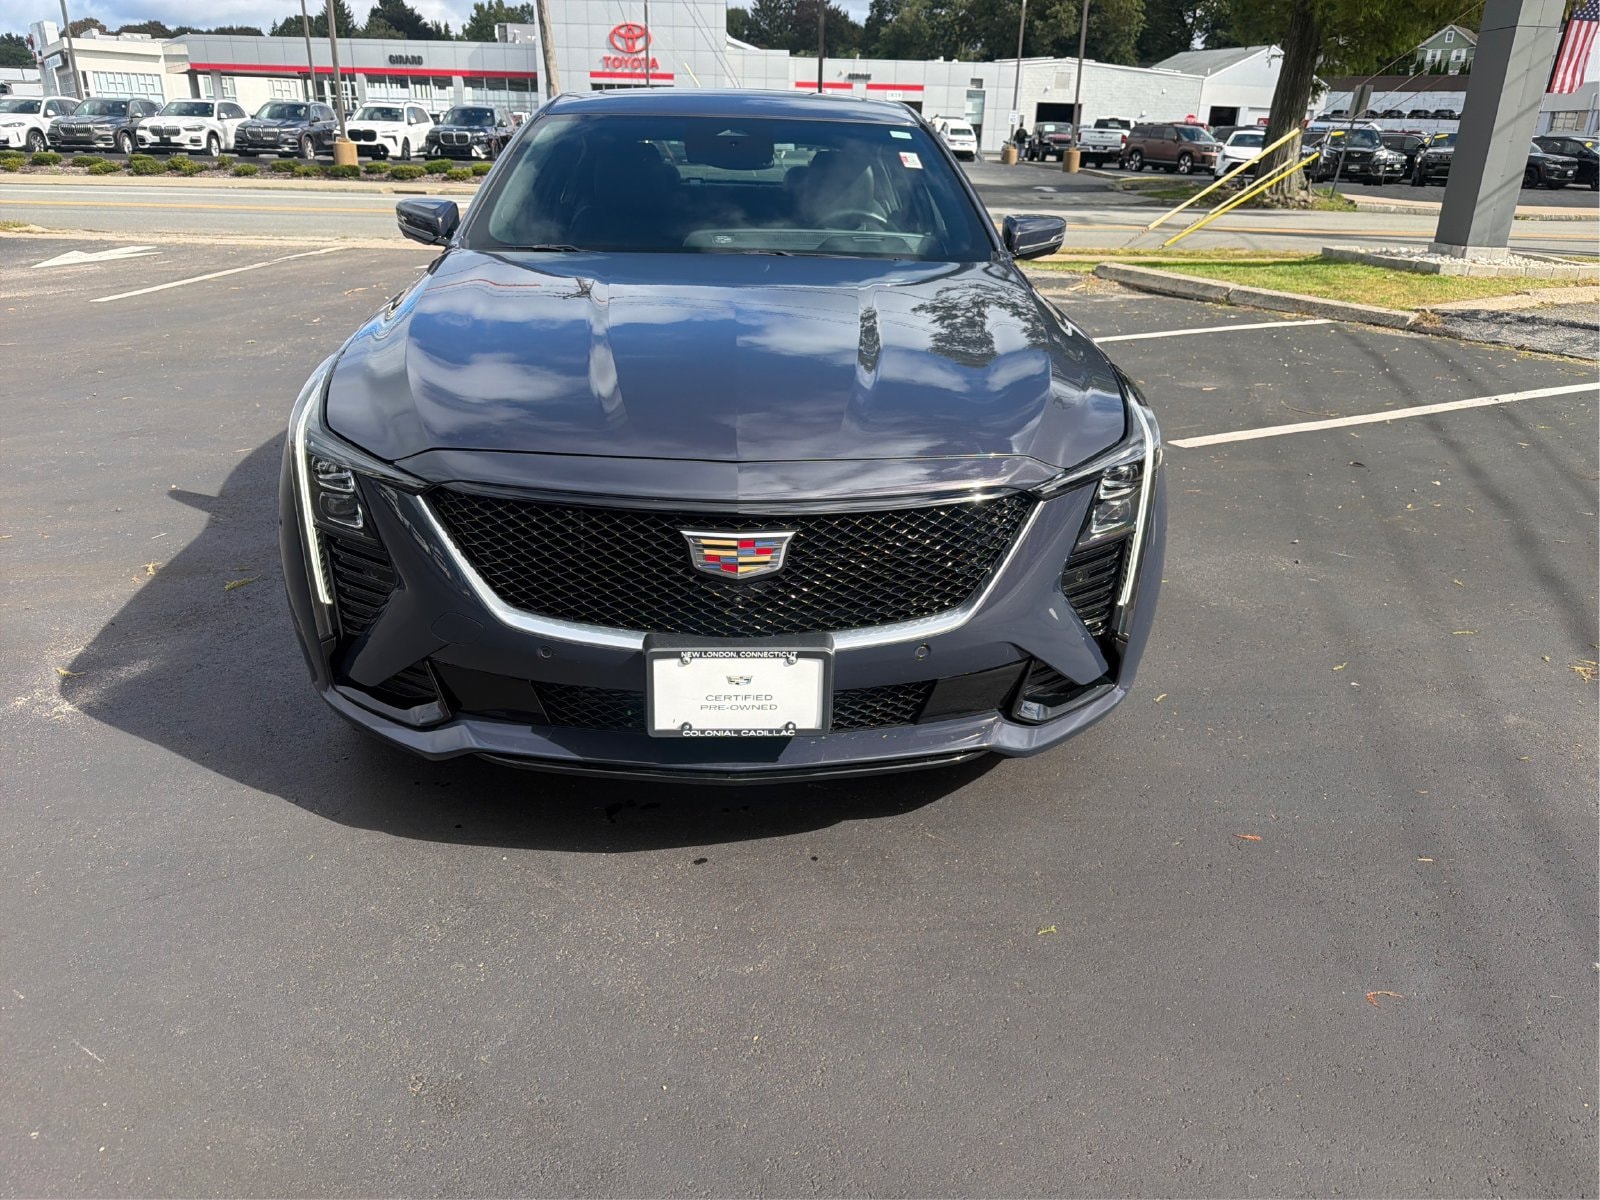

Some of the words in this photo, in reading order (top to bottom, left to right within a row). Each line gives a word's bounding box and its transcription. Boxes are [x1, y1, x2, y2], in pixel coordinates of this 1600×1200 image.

[388, 54, 423, 66] GIRARD
[603, 56, 659, 70] TOYOTA
[705, 694, 773, 702] CERTIFIED
